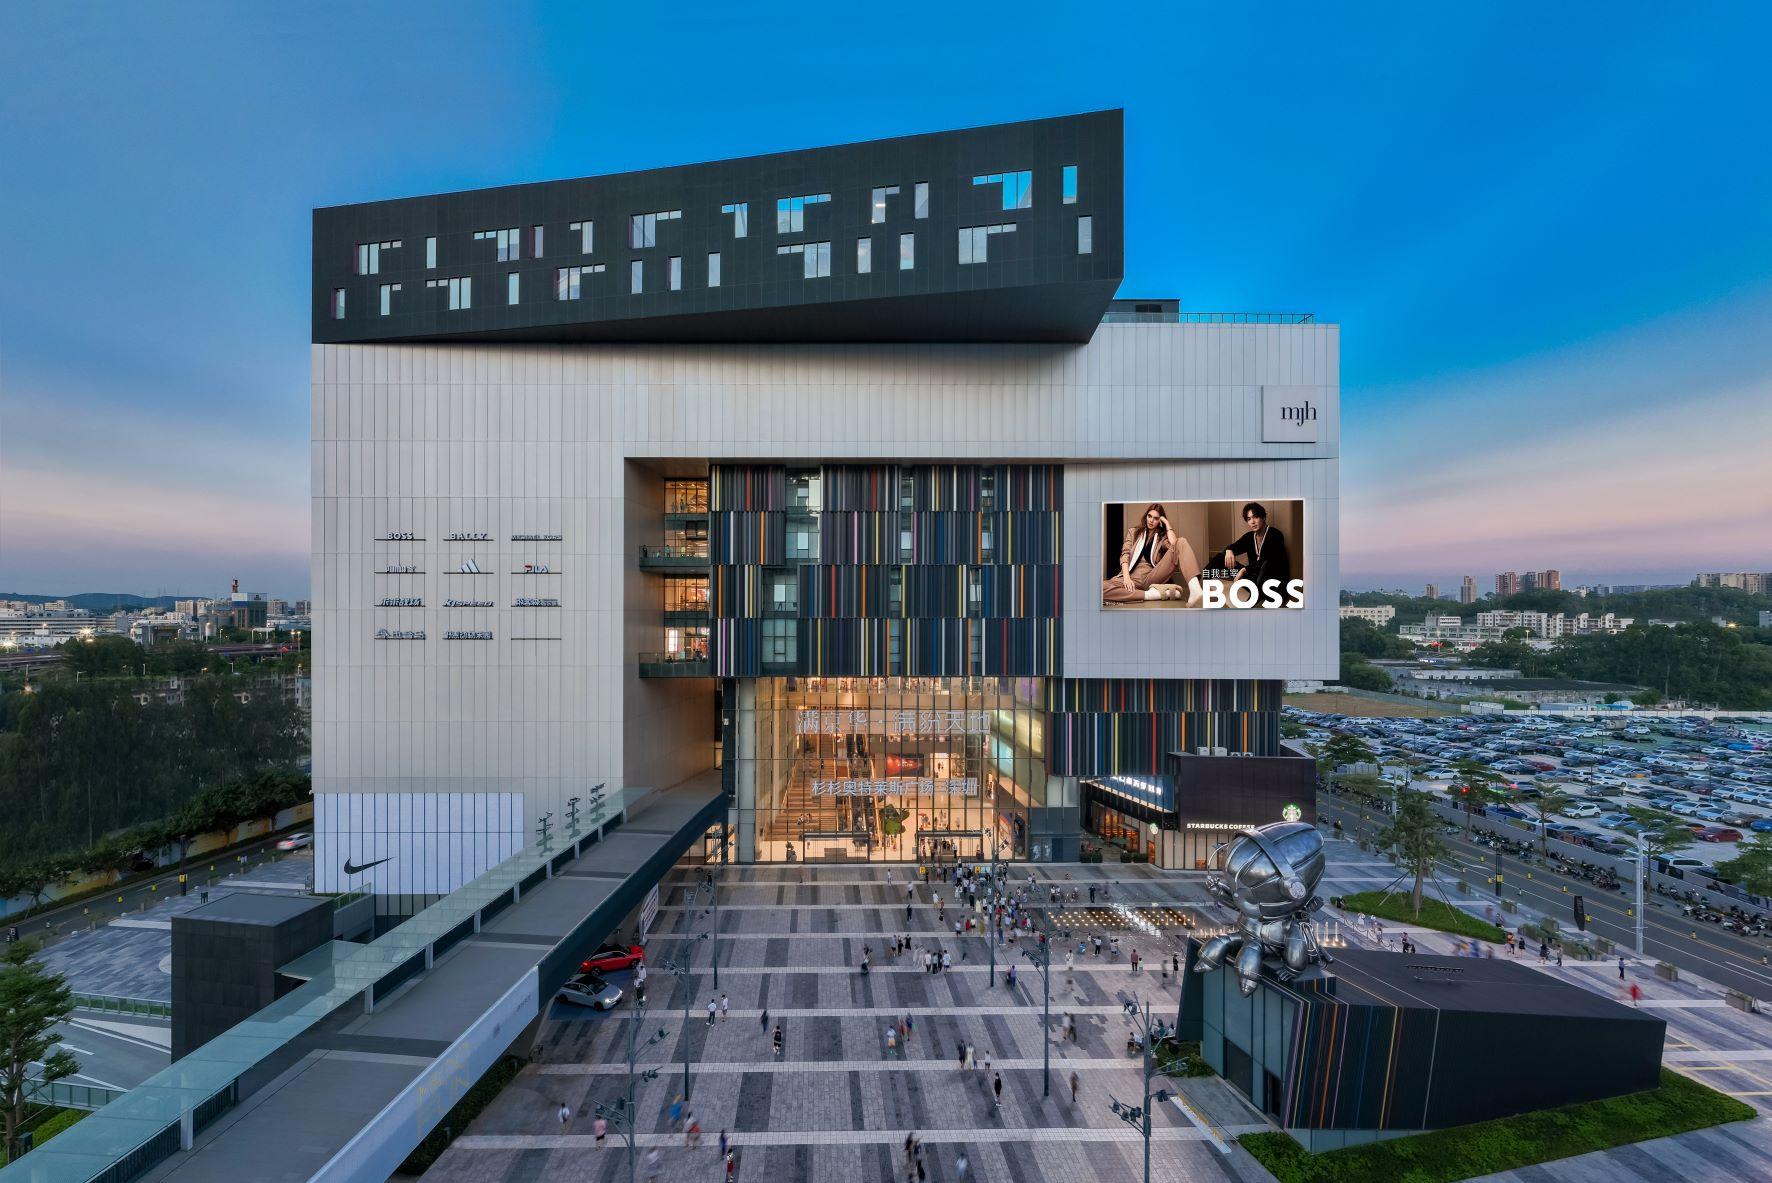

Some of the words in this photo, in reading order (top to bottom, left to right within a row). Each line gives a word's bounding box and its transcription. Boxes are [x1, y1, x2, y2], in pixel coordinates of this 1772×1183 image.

[1281, 401, 1317, 427] mjh
[387, 532, 414, 540] BOSS
[450, 532, 487, 540] BALLY
[524, 565, 549, 573] FILA
[1203, 568, 1238, 579] 自我主宰
[1203, 579, 1304, 609] BOSS
[812, 780, 934, 797] 杉杉奥特莱斯广场
[946, 779, 977, 796] 深圳
